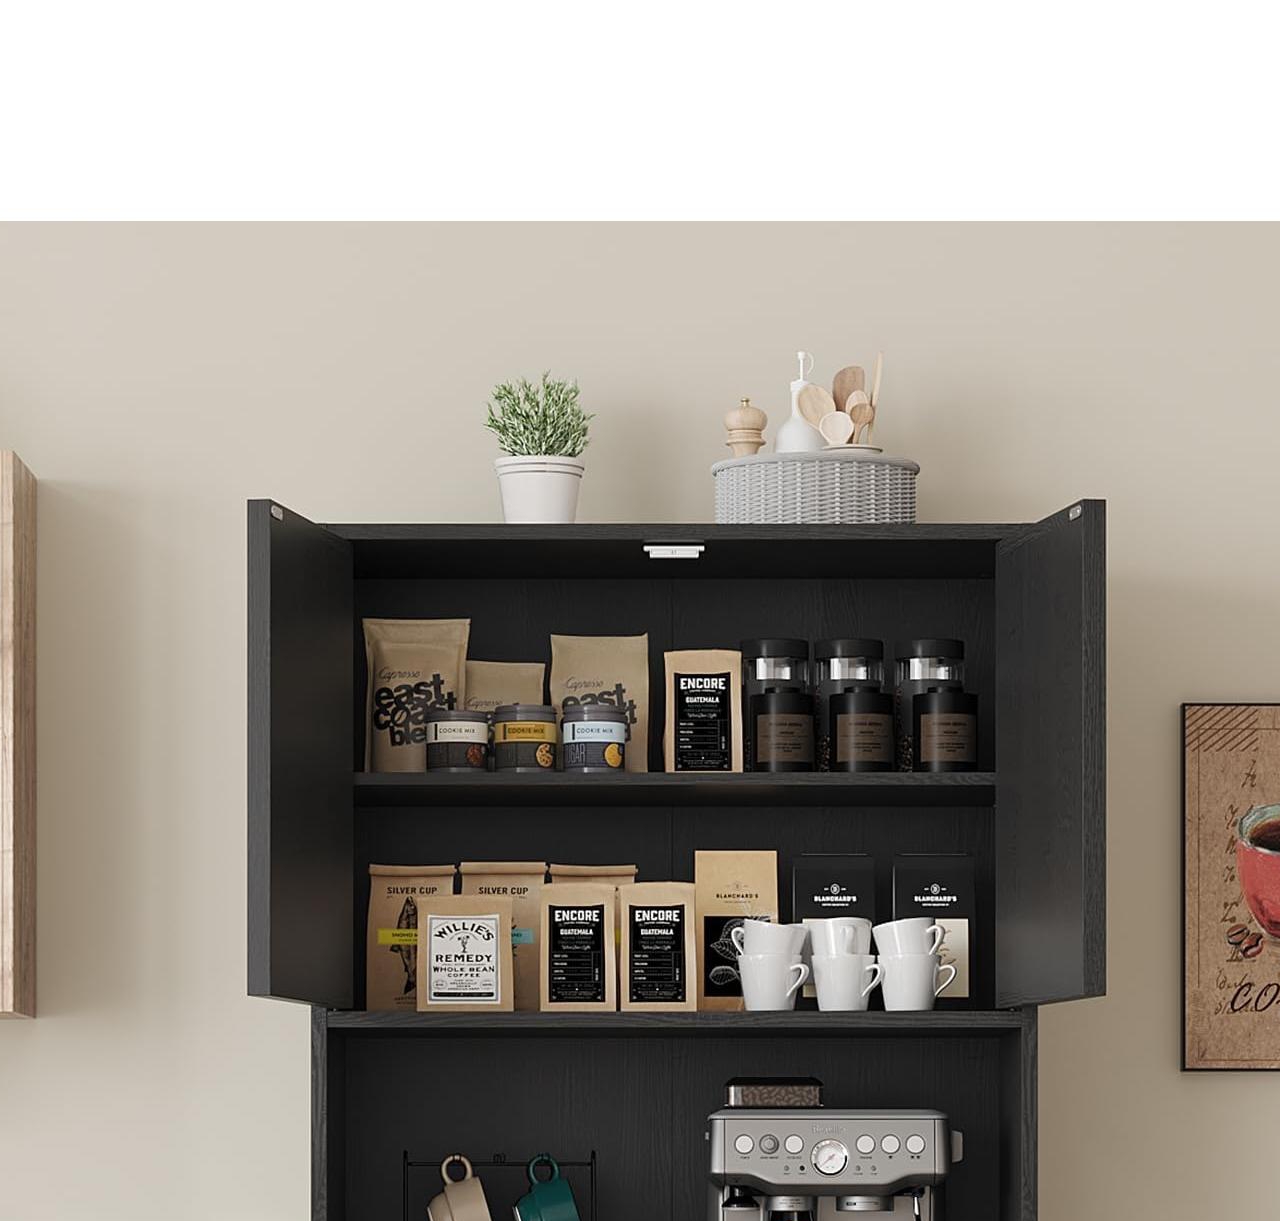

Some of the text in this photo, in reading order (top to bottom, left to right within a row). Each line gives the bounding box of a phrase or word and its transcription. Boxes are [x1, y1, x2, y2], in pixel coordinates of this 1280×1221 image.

[680, 678, 726, 690] ENCORE
[375, 673, 445, 708] east
[387, 886, 438, 895] SILVER CUP
[478, 886, 529, 895] SILVER CUP
[554, 910, 600, 922] ENCORE
[635, 910, 680, 922] ENCORE
[434, 922, 495, 941] WILLIE'S
[435, 954, 492, 963] REMEDY
[433, 965, 495, 973] WHOLE BEAN
